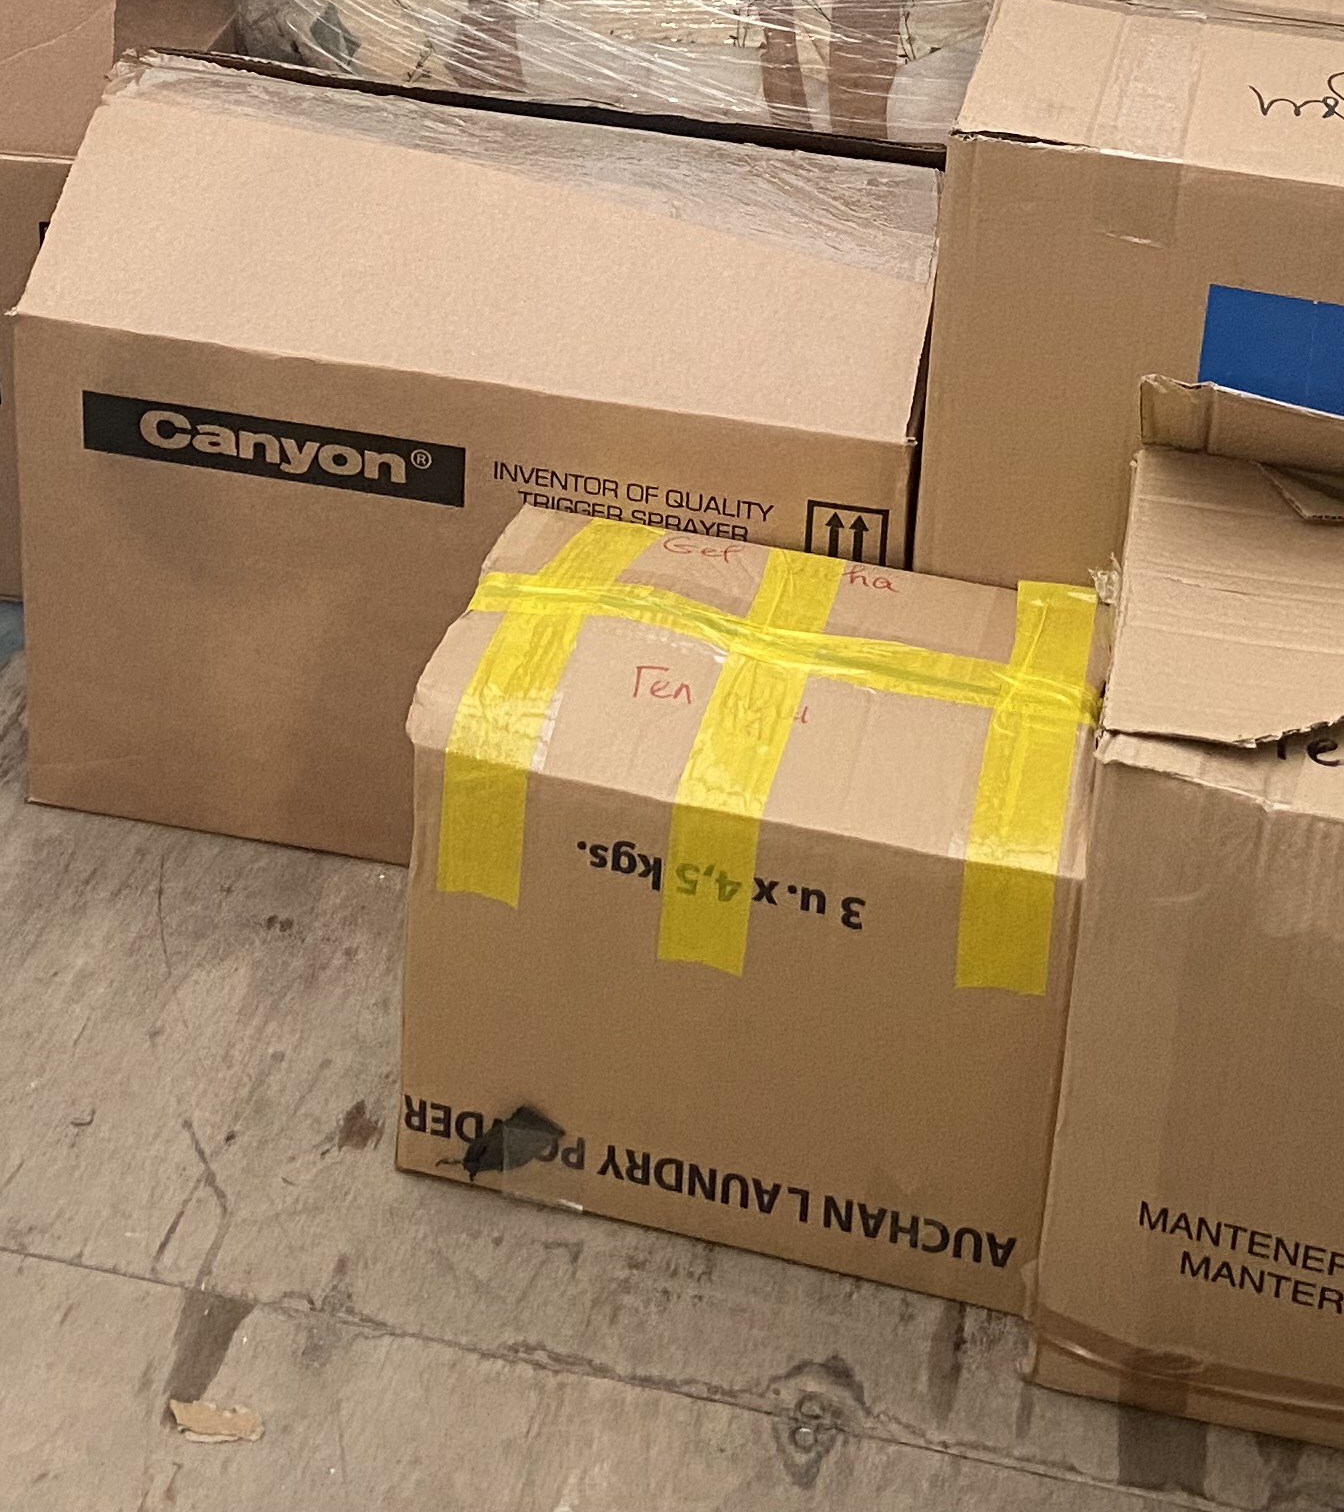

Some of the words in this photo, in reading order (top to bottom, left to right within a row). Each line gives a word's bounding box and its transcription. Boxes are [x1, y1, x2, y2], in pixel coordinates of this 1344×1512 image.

[494, 461, 619, 499] INVENTOR
[626, 483, 660, 504] OF
[665, 489, 775, 522] QUALITY
[630, 509, 749, 542] SPRAYER
[575, 838, 663, 891] kgs.
[674, 862, 746, 903] 4,5
[840, 893, 868, 930] 3
[598, 1143, 810, 1223] LAUNDRY
[824, 1194, 1017, 1269] AUCHAN
